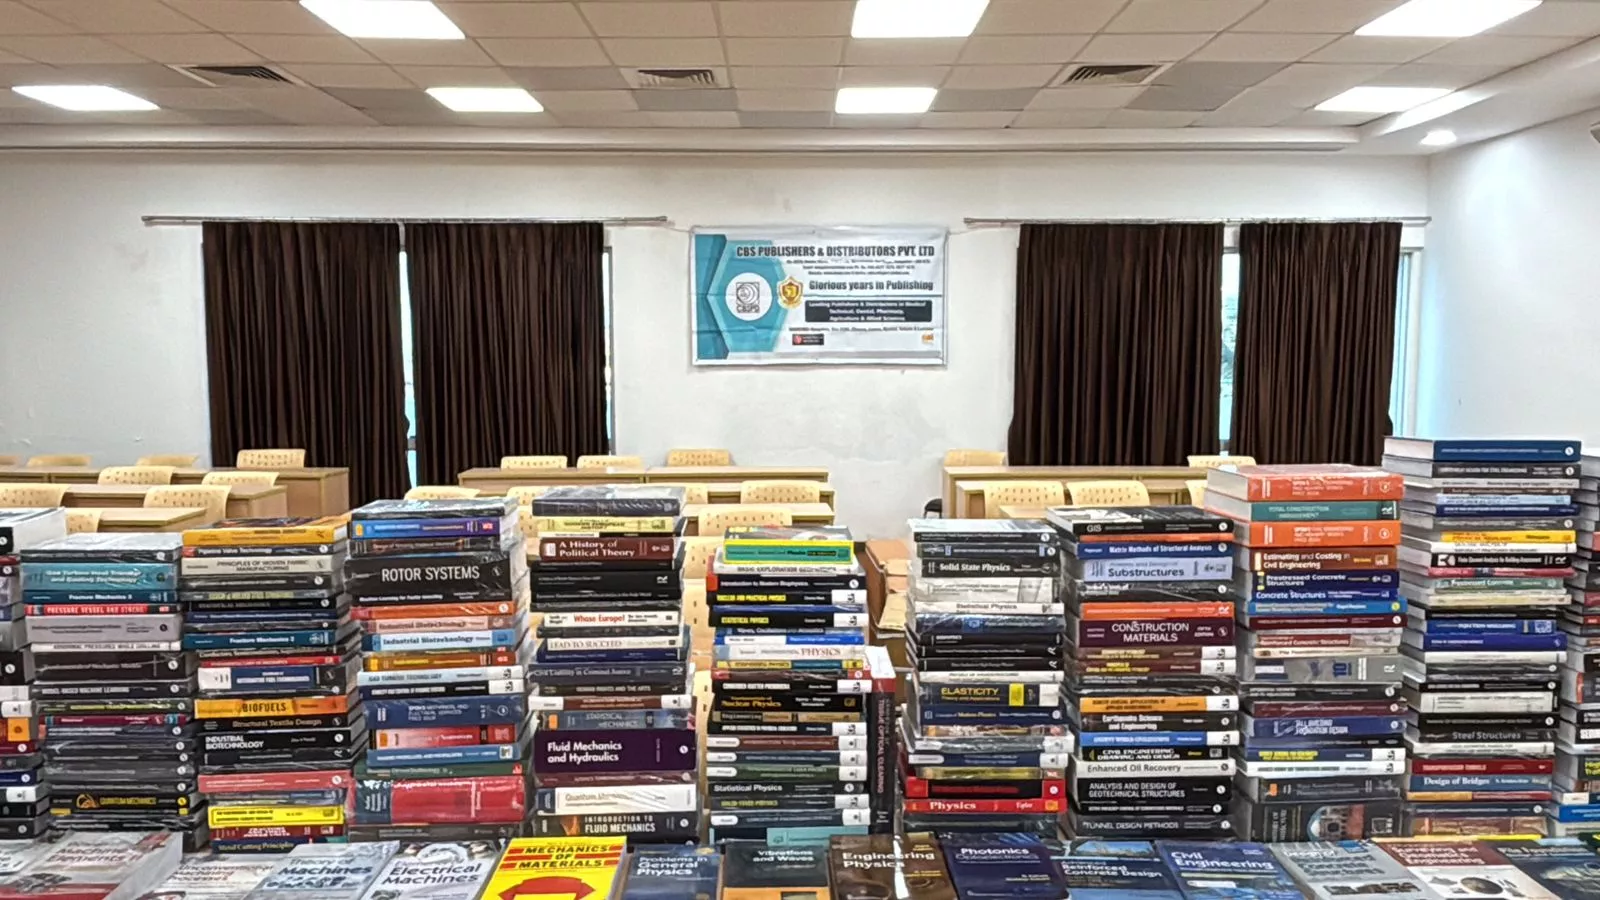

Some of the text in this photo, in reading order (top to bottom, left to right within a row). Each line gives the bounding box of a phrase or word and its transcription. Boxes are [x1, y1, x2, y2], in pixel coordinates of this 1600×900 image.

[736, 246, 756, 256] CBS
[758, 246, 816, 256] PUBLISHERS
[826, 246, 896, 256] DISTRIBUTORS
[918, 246, 935, 256] LTD
[809, 280, 934, 292] Glorious years in Publishing
[1087, 524, 1102, 532] GIS
[570, 541, 604, 549] History
[603, 550, 635, 558] Theory
[1316, 553, 1342, 561] Costing
[982, 564, 1010, 573] Physics
[1279, 561, 1321, 570] Engineering
[382, 566, 480, 582] ROTOR SYSTEMS
[1108, 568, 1184, 577] Substructures
[1112, 623, 1189, 632] CONSTRUCTION
[421, 636, 473, 644] Biotechnology
[1123, 633, 1178, 642] MATERIALS
[242, 703, 286, 713] BIOFUELS
[548, 740, 622, 752] Fluid Mechanics
[548, 752, 619, 765] and Hydraulics
[1088, 764, 1128, 773] Enhanced
[1144, 763, 1181, 773] Recovery
[1424, 777, 1450, 785] Design
[1462, 777, 1490, 786] Bridges
[753, 784, 782, 792] Physics
[930, 801, 976, 810] Physics
[585, 822, 656, 833] FLUID MECHANICS
[844, 861, 906, 869] Physics
[1175, 858, 1275, 870] Engineering
[278, 866, 374, 874] Machines
[389, 864, 482, 875] Electrical
[636, 868, 693, 876] Physics
[1121, 869, 1163, 877] Design
[382, 874, 478, 885] Machines
